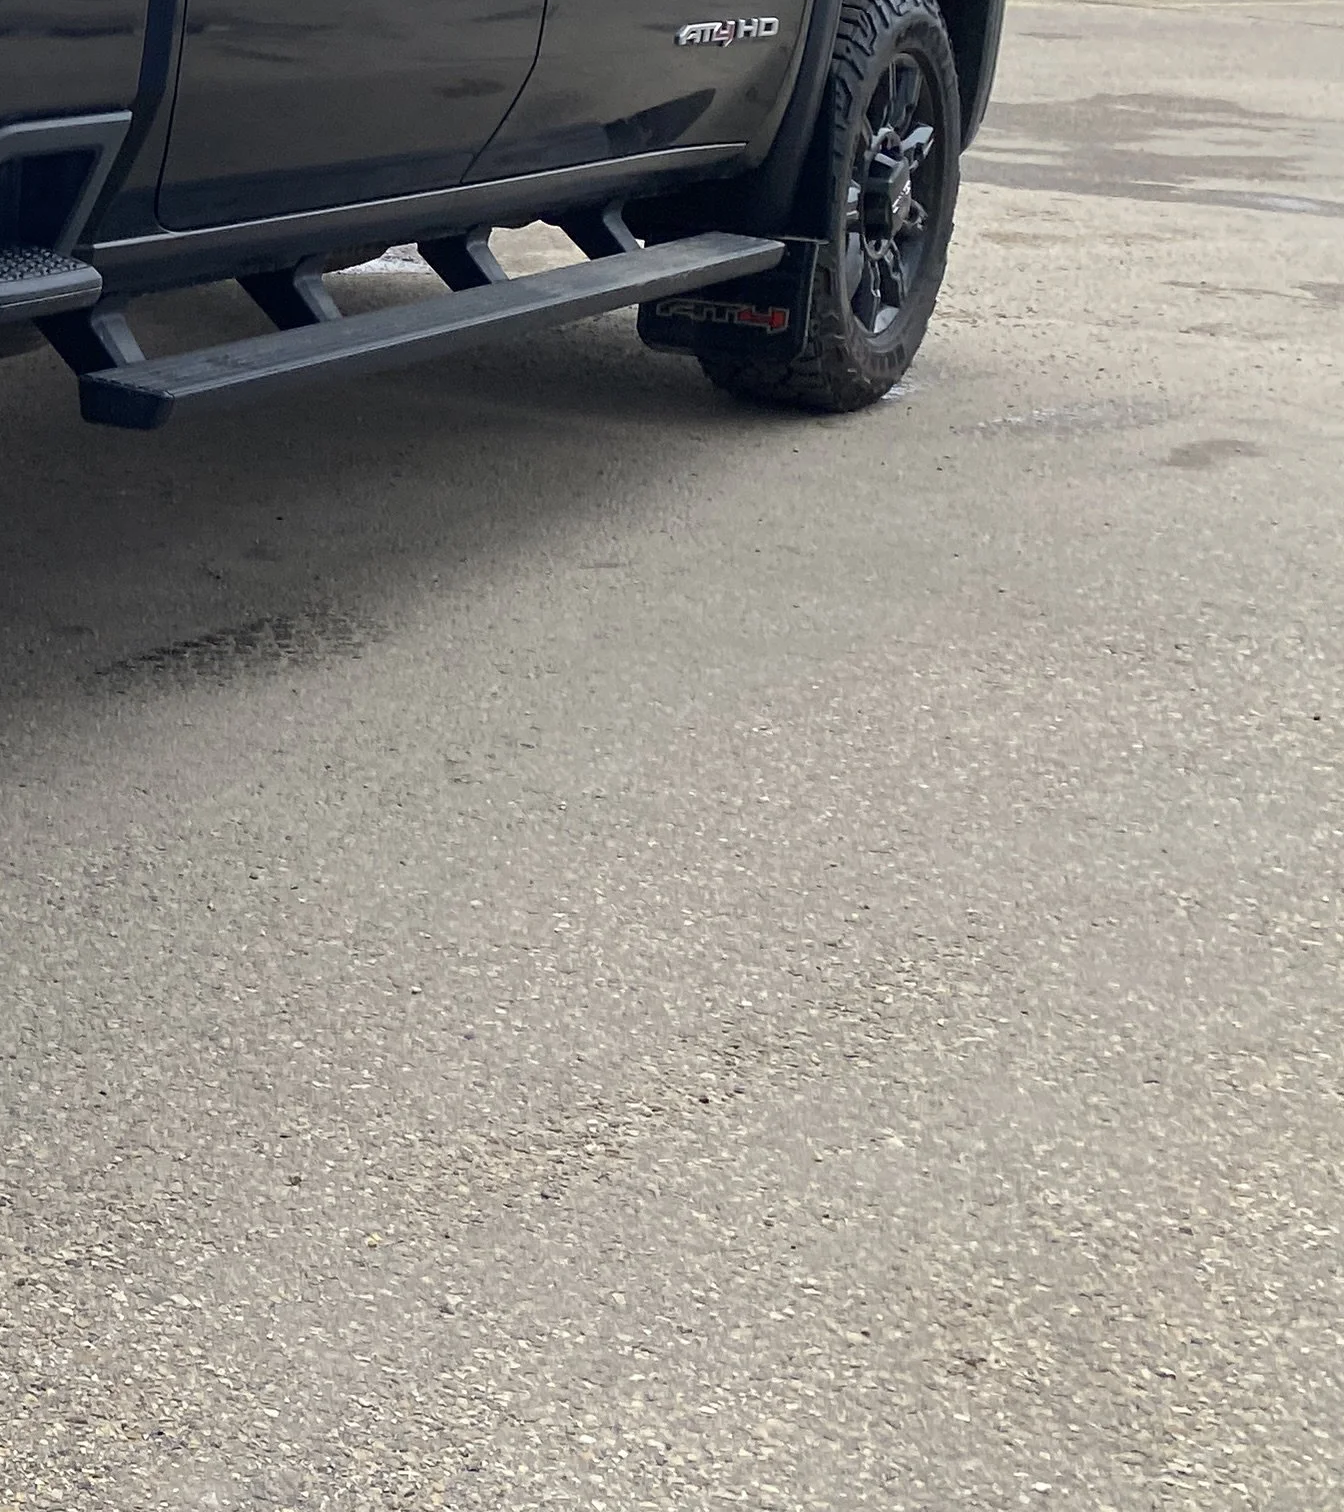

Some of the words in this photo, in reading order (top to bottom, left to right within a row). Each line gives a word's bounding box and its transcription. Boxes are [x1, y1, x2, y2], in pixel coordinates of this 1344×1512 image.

[675, 20, 736, 47] AT4
[737, 17, 780, 38] HD
[656, 297, 790, 335] AT4
